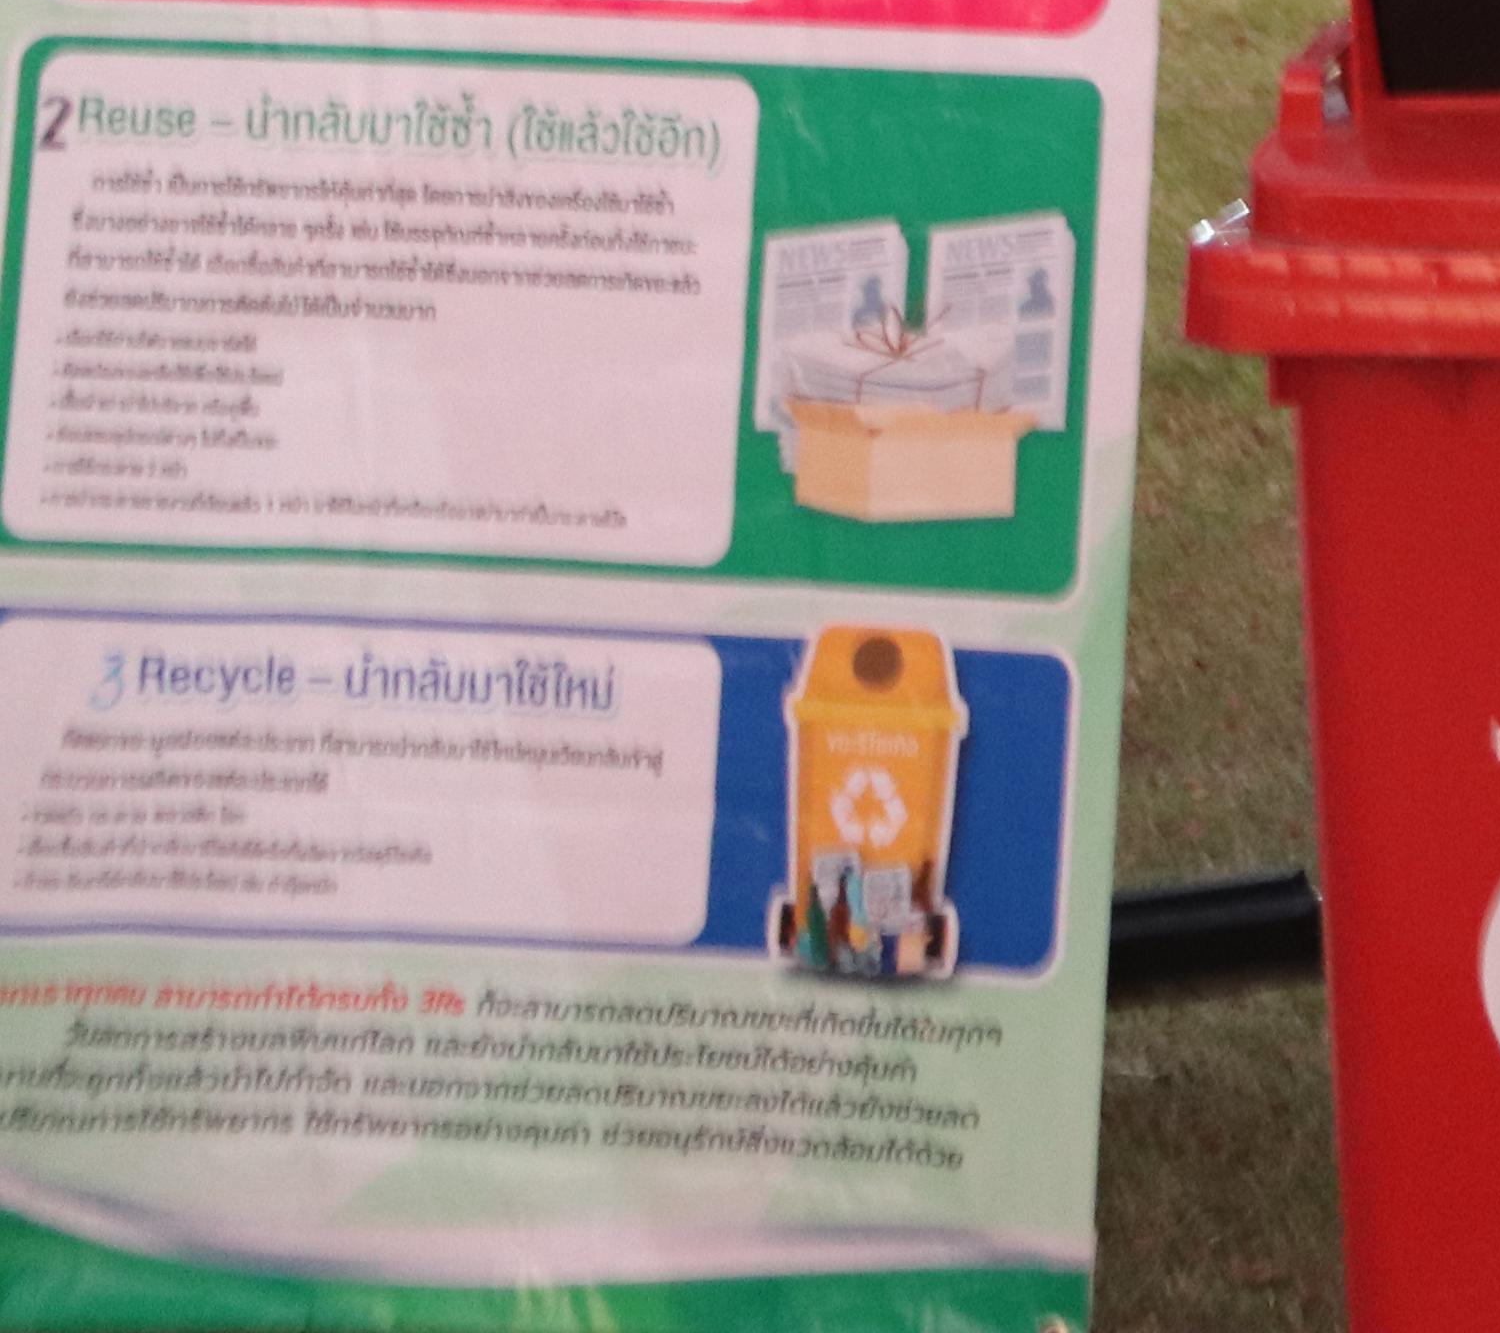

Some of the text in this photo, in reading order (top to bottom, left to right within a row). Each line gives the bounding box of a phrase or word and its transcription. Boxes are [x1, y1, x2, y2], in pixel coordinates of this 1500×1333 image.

[76, 95, 198, 139] Reuse
[138, 655, 296, 706] Recycle
[343, 652, 617, 712] นำกลับมาใช้ใหม่
